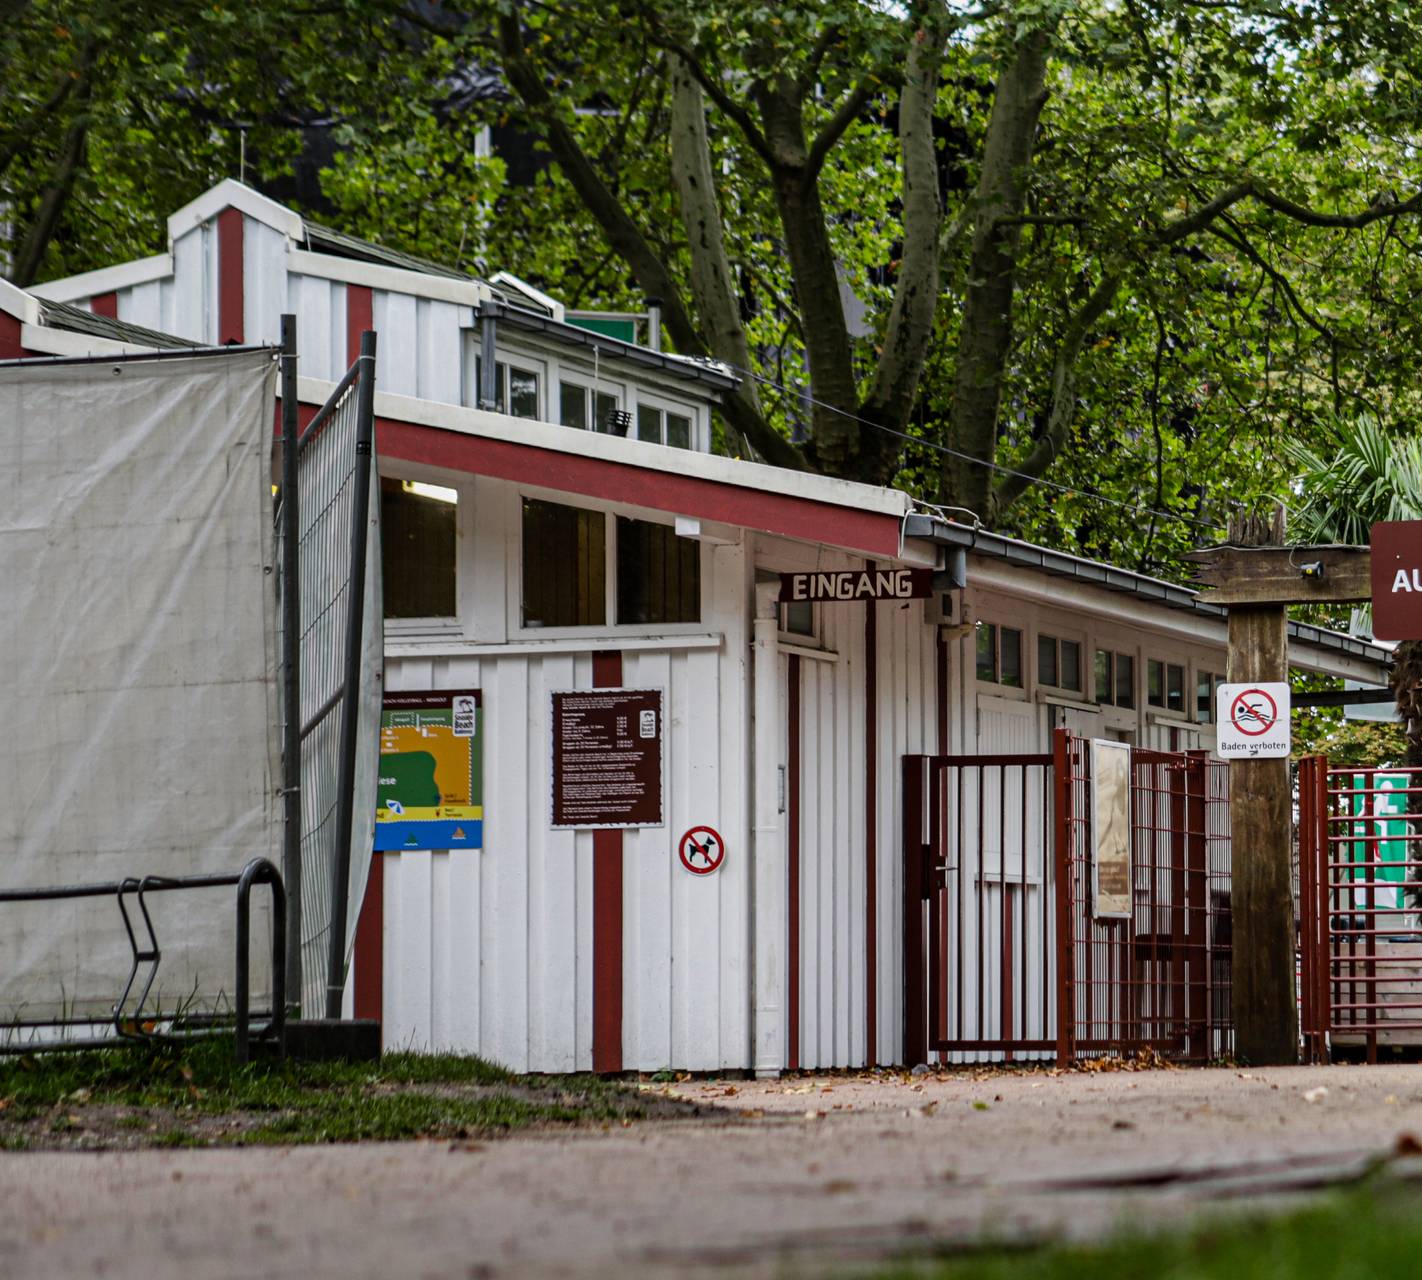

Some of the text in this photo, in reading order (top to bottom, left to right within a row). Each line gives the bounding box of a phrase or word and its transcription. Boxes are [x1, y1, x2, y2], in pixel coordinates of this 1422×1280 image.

[793, 570, 913, 600] EINGANG
[455, 721, 473, 730] Beach
[1221, 741, 1287, 751] Baden verboten
